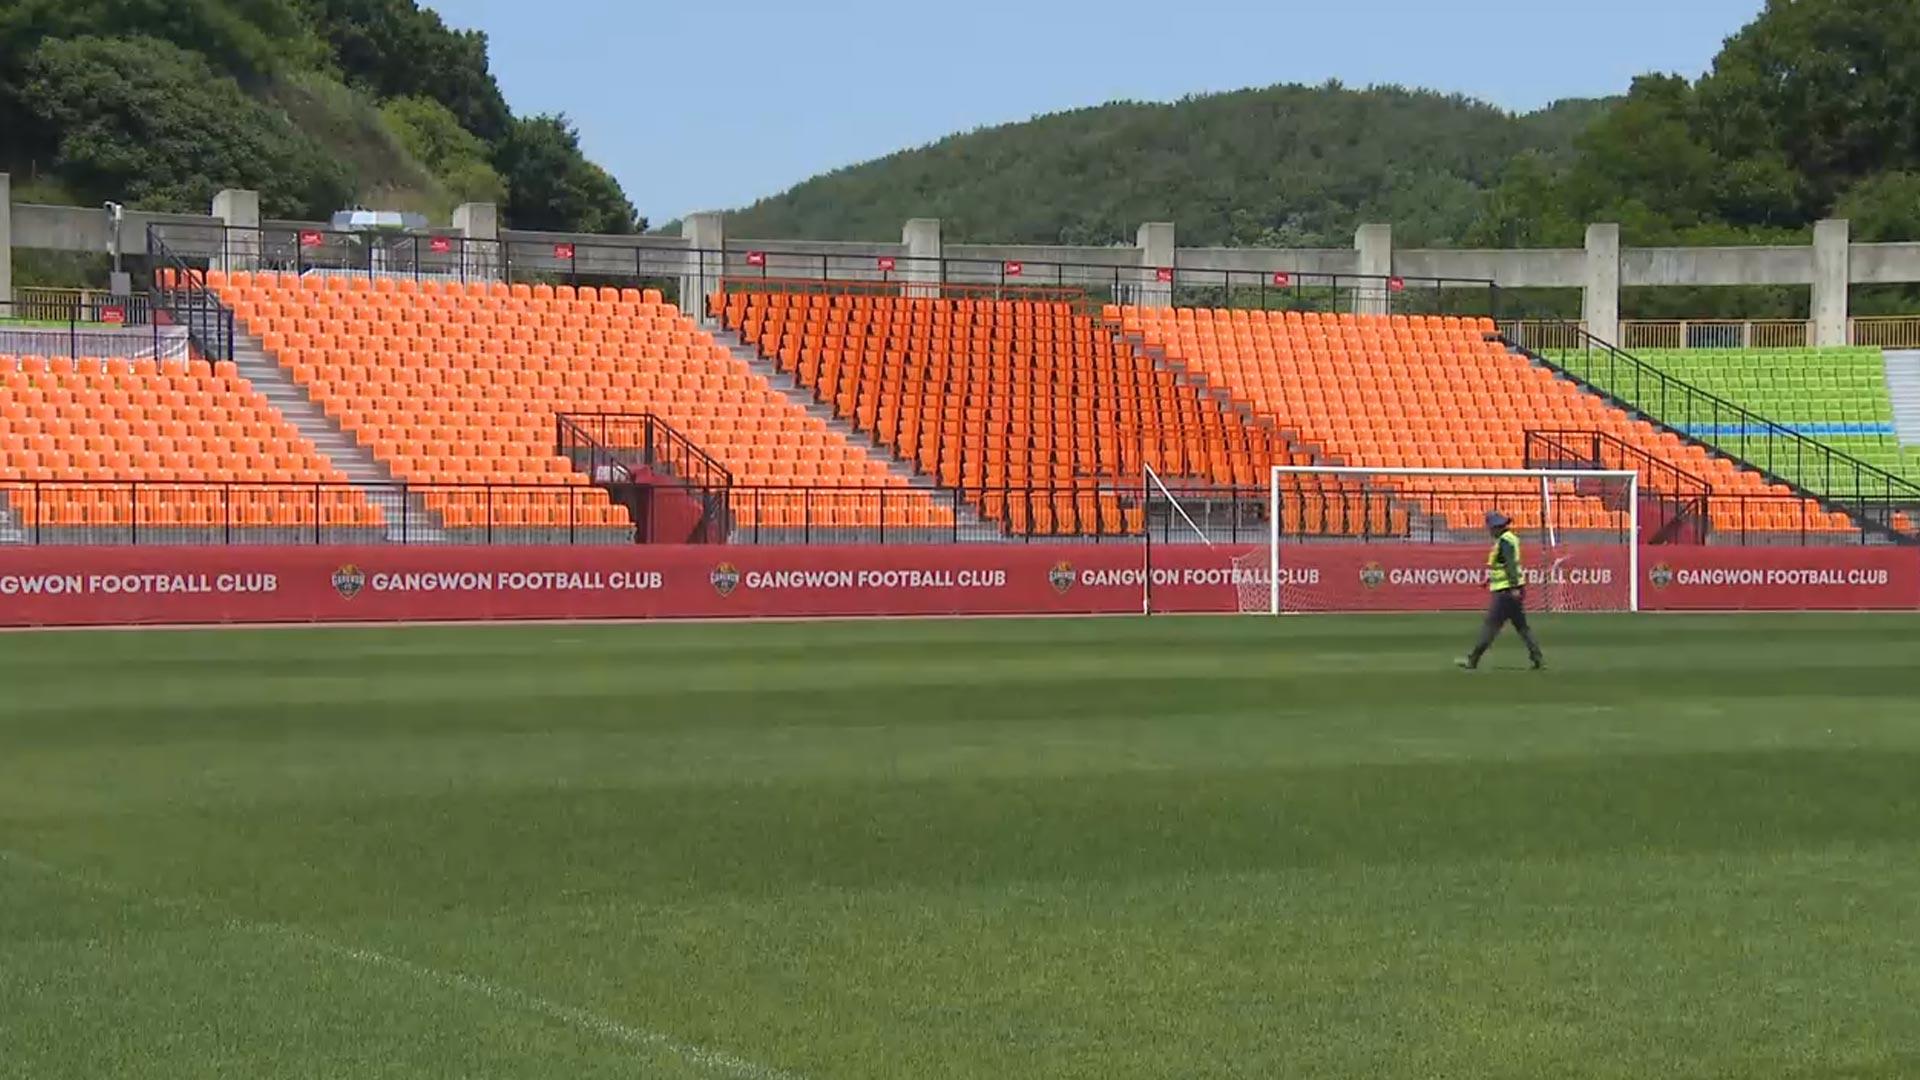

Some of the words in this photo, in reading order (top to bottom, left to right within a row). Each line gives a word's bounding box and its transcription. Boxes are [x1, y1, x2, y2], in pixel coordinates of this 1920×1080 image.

[89, 575, 212, 593] FOOTBALL
[216, 574, 277, 592] CLUB
[371, 573, 492, 591] GANGWON
[498, 572, 605, 590] FOOTBALL
[608, 572, 662, 589] CLUB
[745, 571, 853, 588] GANGWON
[858, 570, 954, 587] FOOTBALL
[957, 570, 1006, 587] CLUB
[1081, 569, 1180, 586] GANGWON
[1183, 569, 1272, 585] FOOTBALL
[1275, 568, 1320, 585] CLUB
[1389, 568, 1481, 585] GANGWON
[1569, 568, 1612, 585] CLUB
[1677, 569, 1764, 585] GANGWON
[1766, 569, 1846, 585] FOOTBALL
[1847, 569, 1888, 585] CLUB
